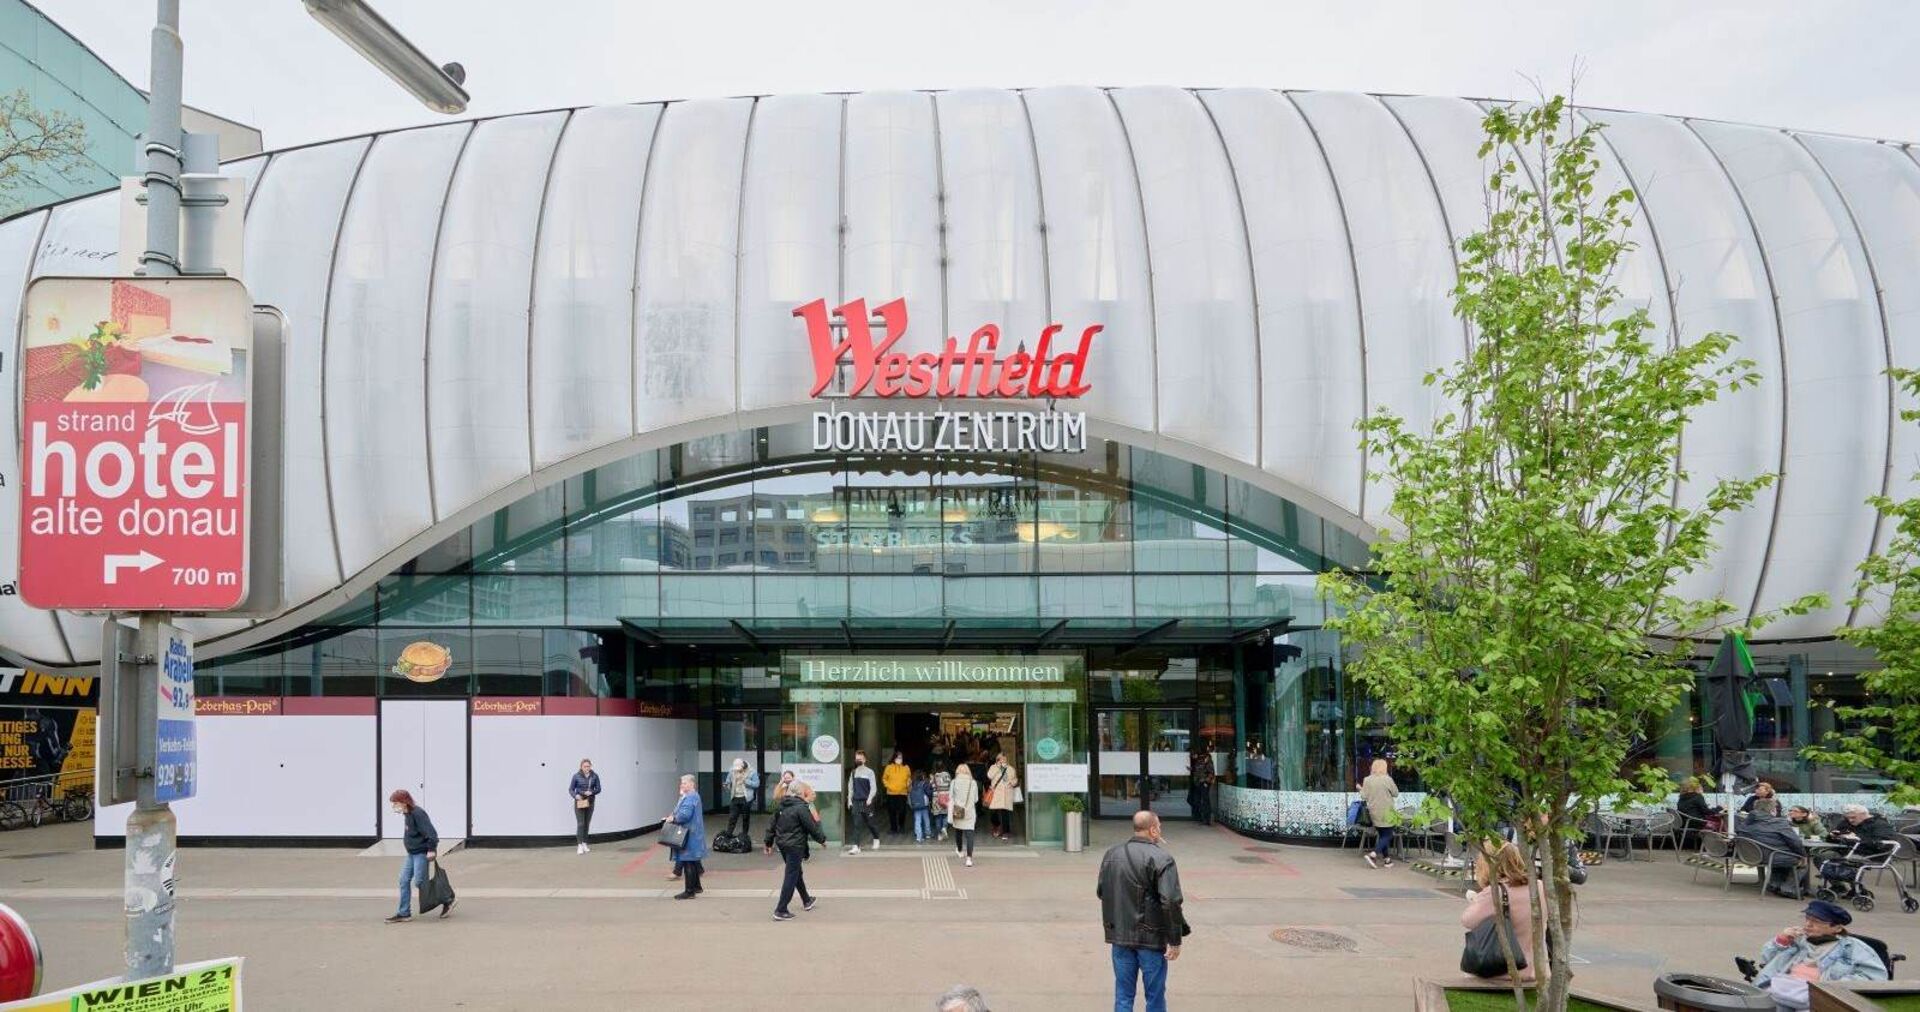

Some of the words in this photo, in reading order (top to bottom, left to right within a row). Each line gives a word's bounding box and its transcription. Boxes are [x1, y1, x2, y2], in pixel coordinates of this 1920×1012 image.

[792, 297, 1104, 399] Westfield
[57, 409, 135, 432] strand
[812, 411, 925, 452] DONAU
[934, 411, 1086, 452] ZENTRUM
[31, 421, 238, 499] hotel
[30, 498, 103, 536] alte
[118, 498, 237, 537] donau
[172, 567, 210, 586] 700
[217, 572, 237, 586] m
[163, 651, 194, 684] Arabell
[806, 660, 905, 682] Herzlich
[914, 660, 1060, 682] willkommen
[82, 976, 187, 1006] WIEN
[199, 967, 233, 985] 21
